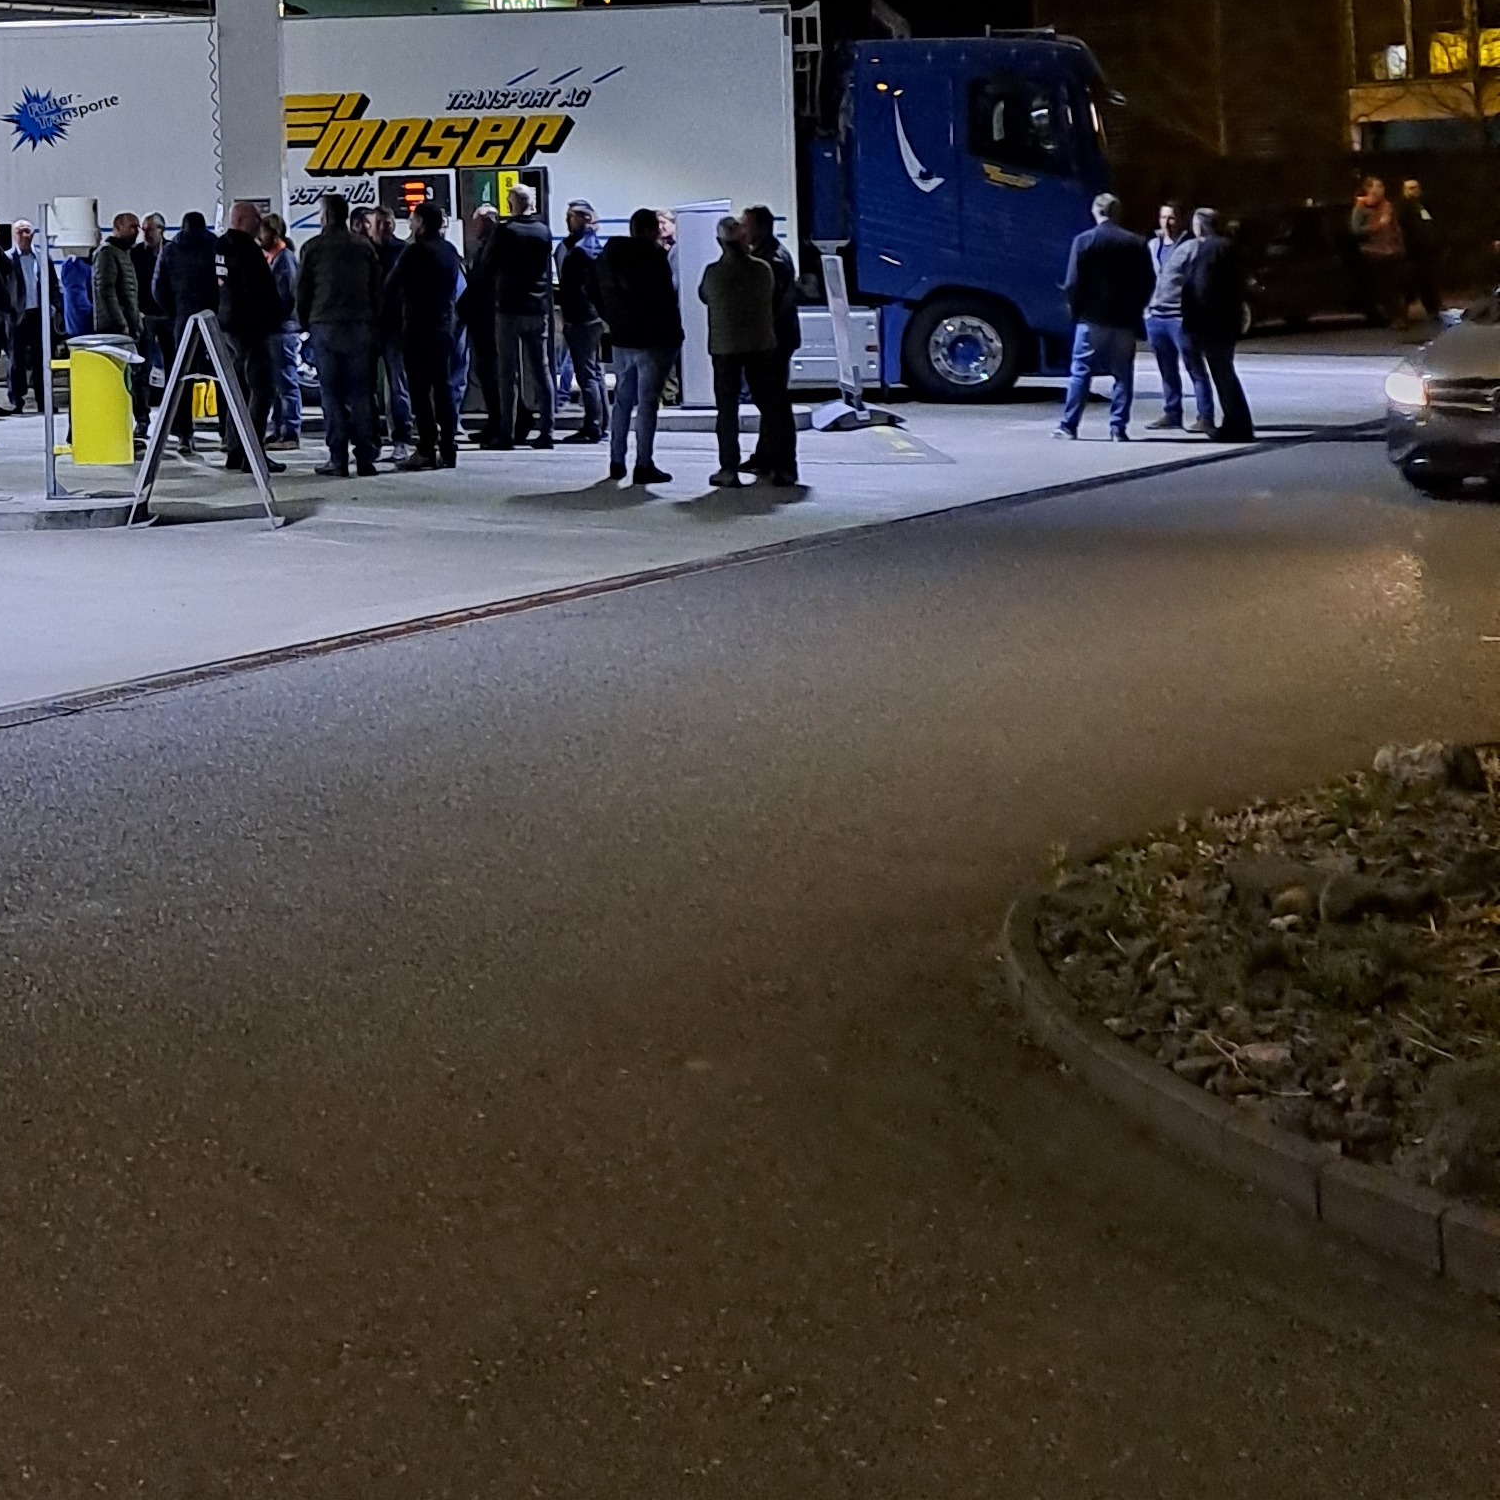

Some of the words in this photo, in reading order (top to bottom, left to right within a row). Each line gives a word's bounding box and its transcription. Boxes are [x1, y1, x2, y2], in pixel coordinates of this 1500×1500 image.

[39, 95, 120, 129] Transporte
[446, 88, 561, 110] TRANSPORT
[557, 86, 592, 108] AG
